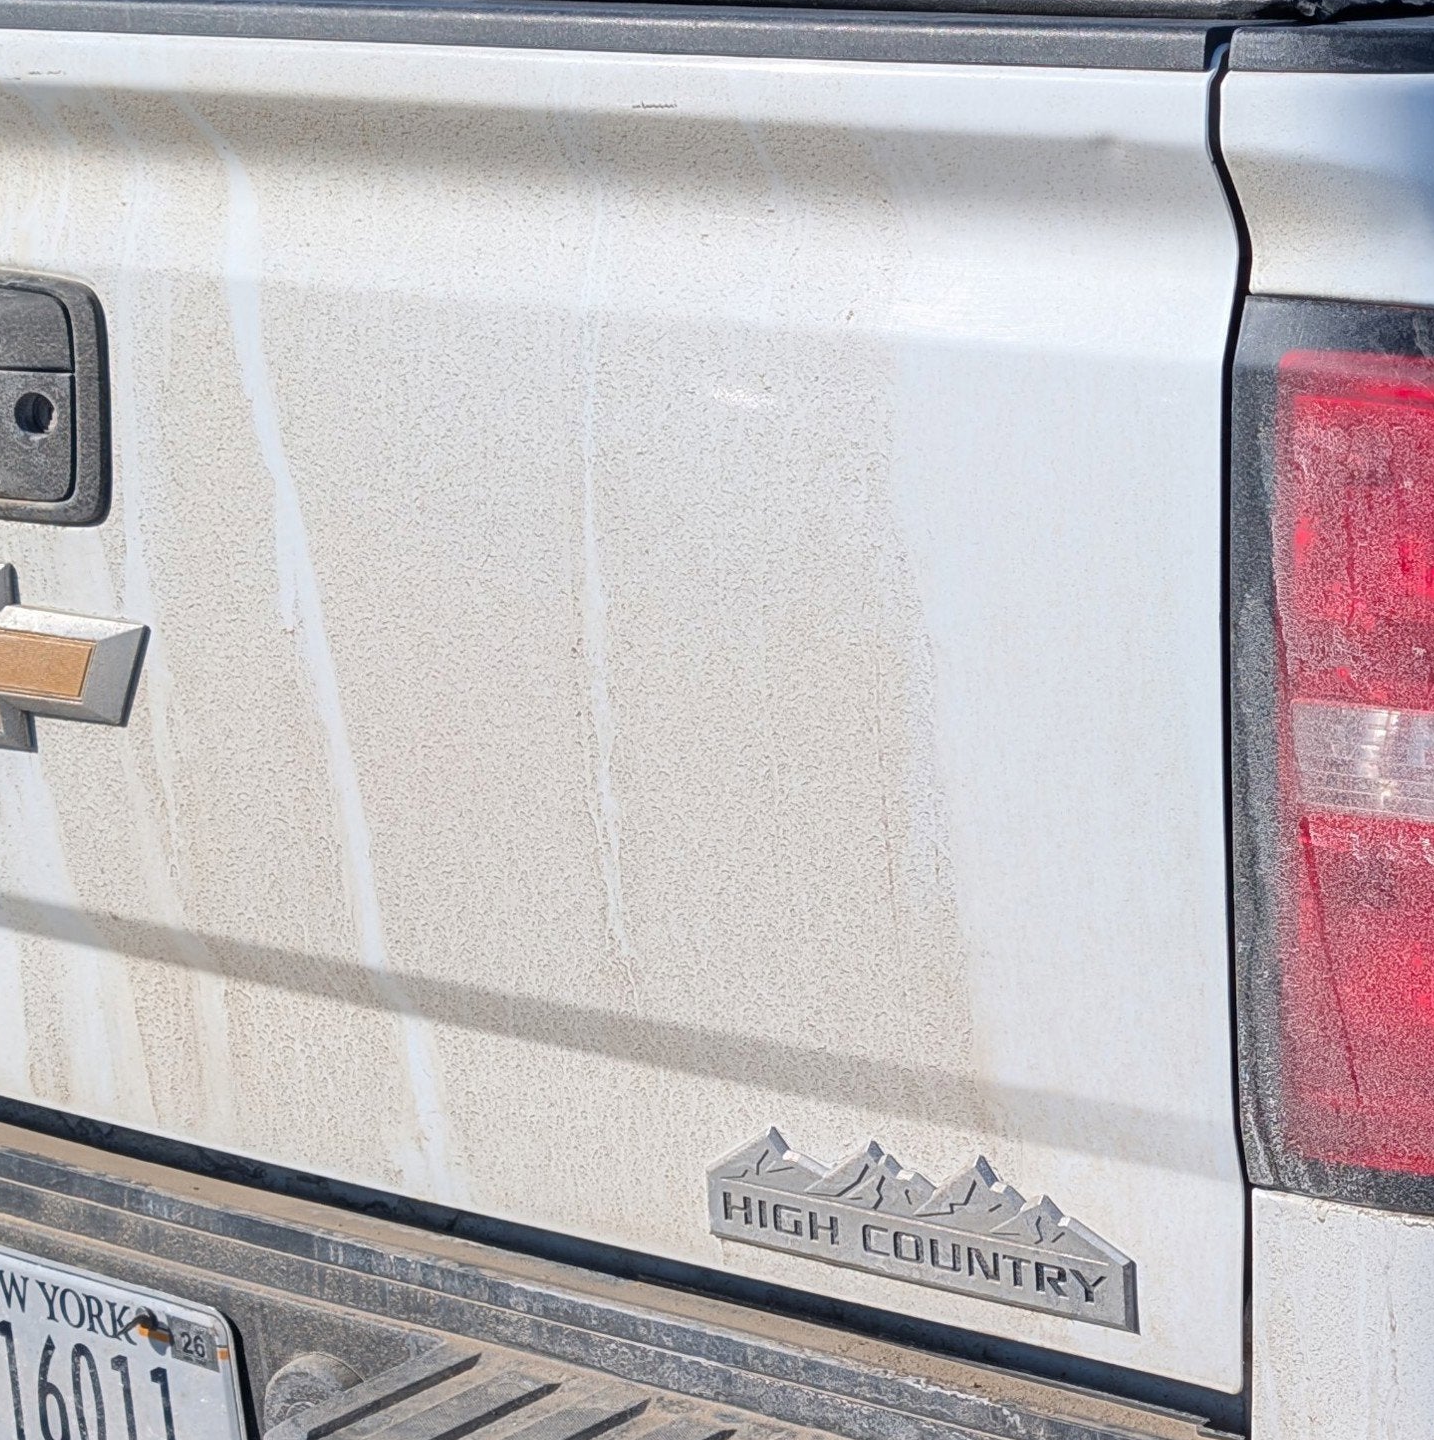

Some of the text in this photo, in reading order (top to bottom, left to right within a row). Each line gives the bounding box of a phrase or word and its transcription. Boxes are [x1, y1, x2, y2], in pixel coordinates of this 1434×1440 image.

[722, 1191, 1107, 1304] HIGH COUNTRY
[36, 1280, 138, 1346] YORK
[179, 1331, 206, 1358] 26
